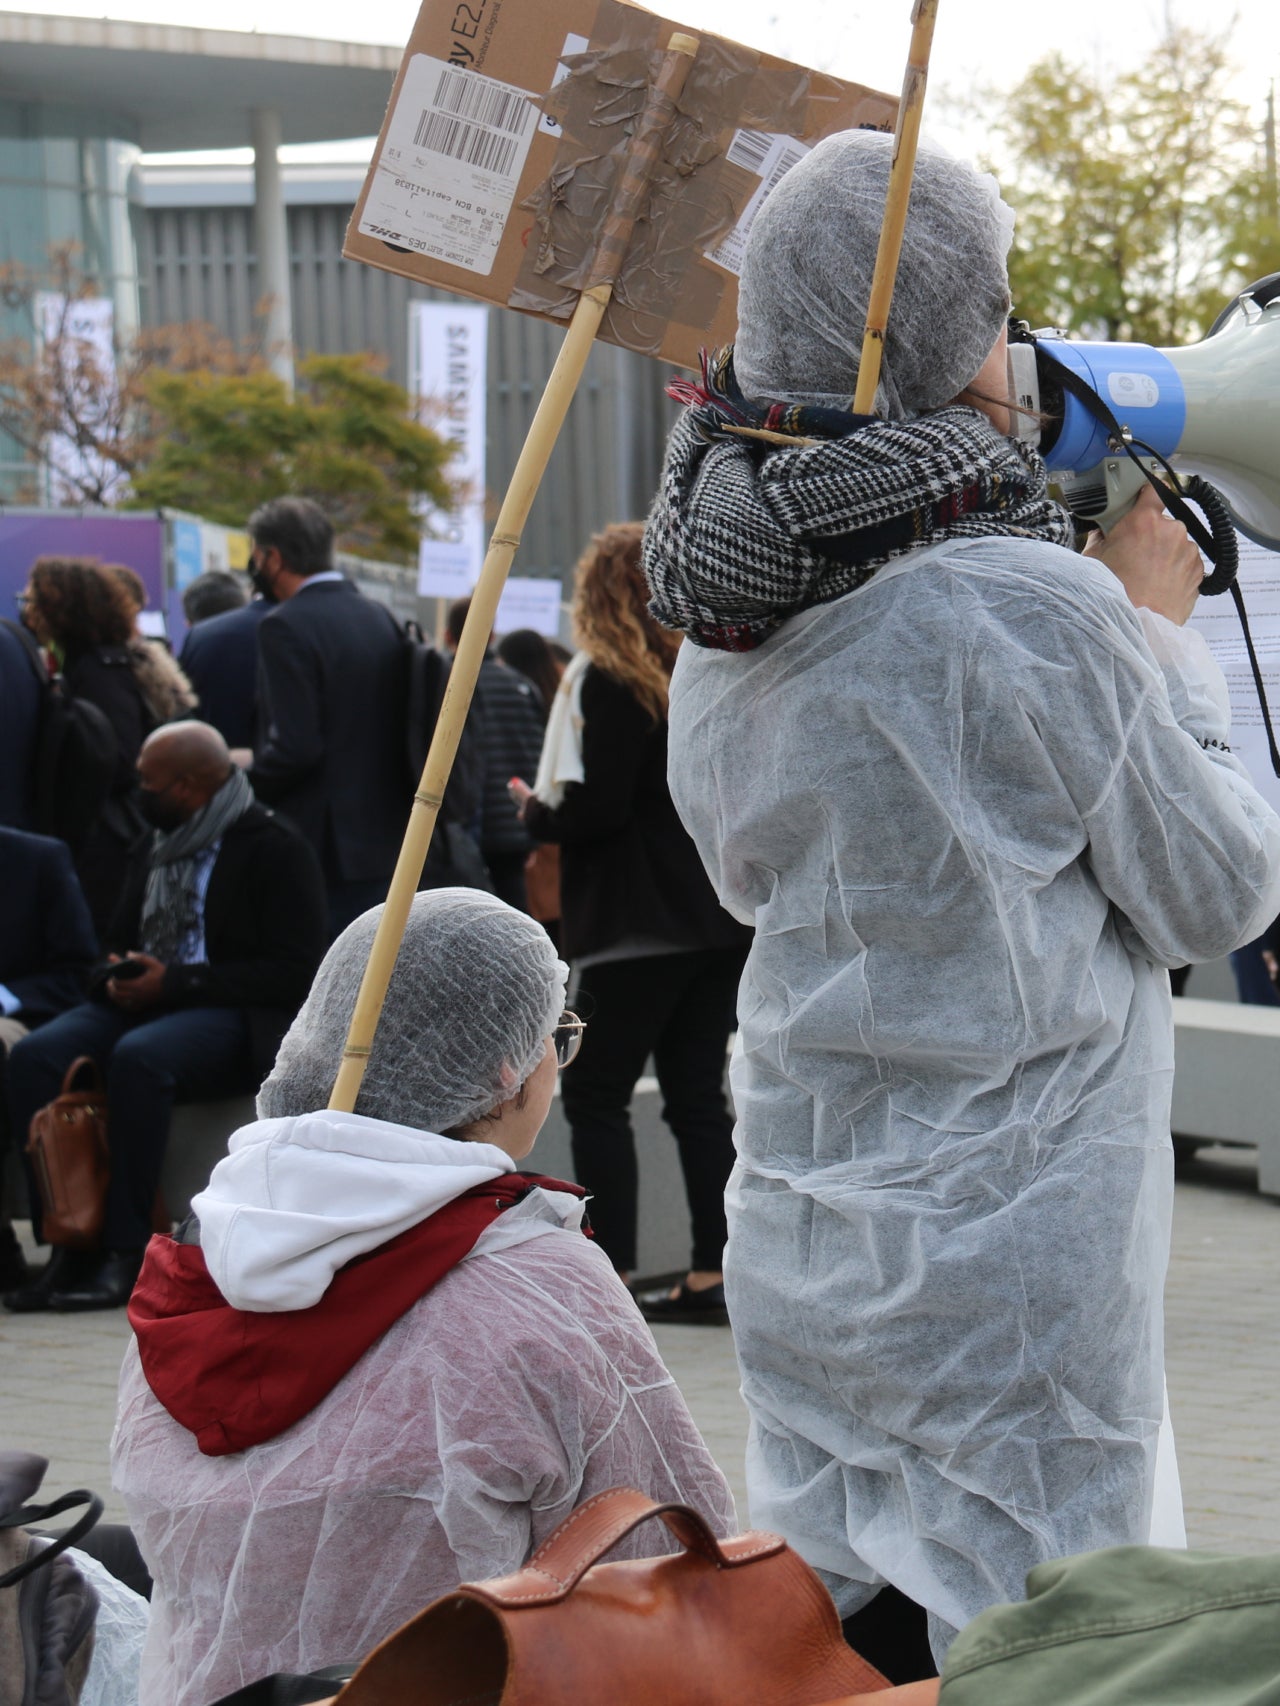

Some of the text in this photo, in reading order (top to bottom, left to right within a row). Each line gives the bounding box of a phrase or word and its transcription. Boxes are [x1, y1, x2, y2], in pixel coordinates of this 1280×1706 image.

[450, 0, 486, 38] E2
[474, 1, 502, 69] Moniteur Diagonal
[393, 177, 452, 202] capital1038
[454, 198, 472, 210] BCN
[367, 223, 402, 241] DHL
[407, 236, 427, 250] DES
[426, 243, 444, 255] SELECT
